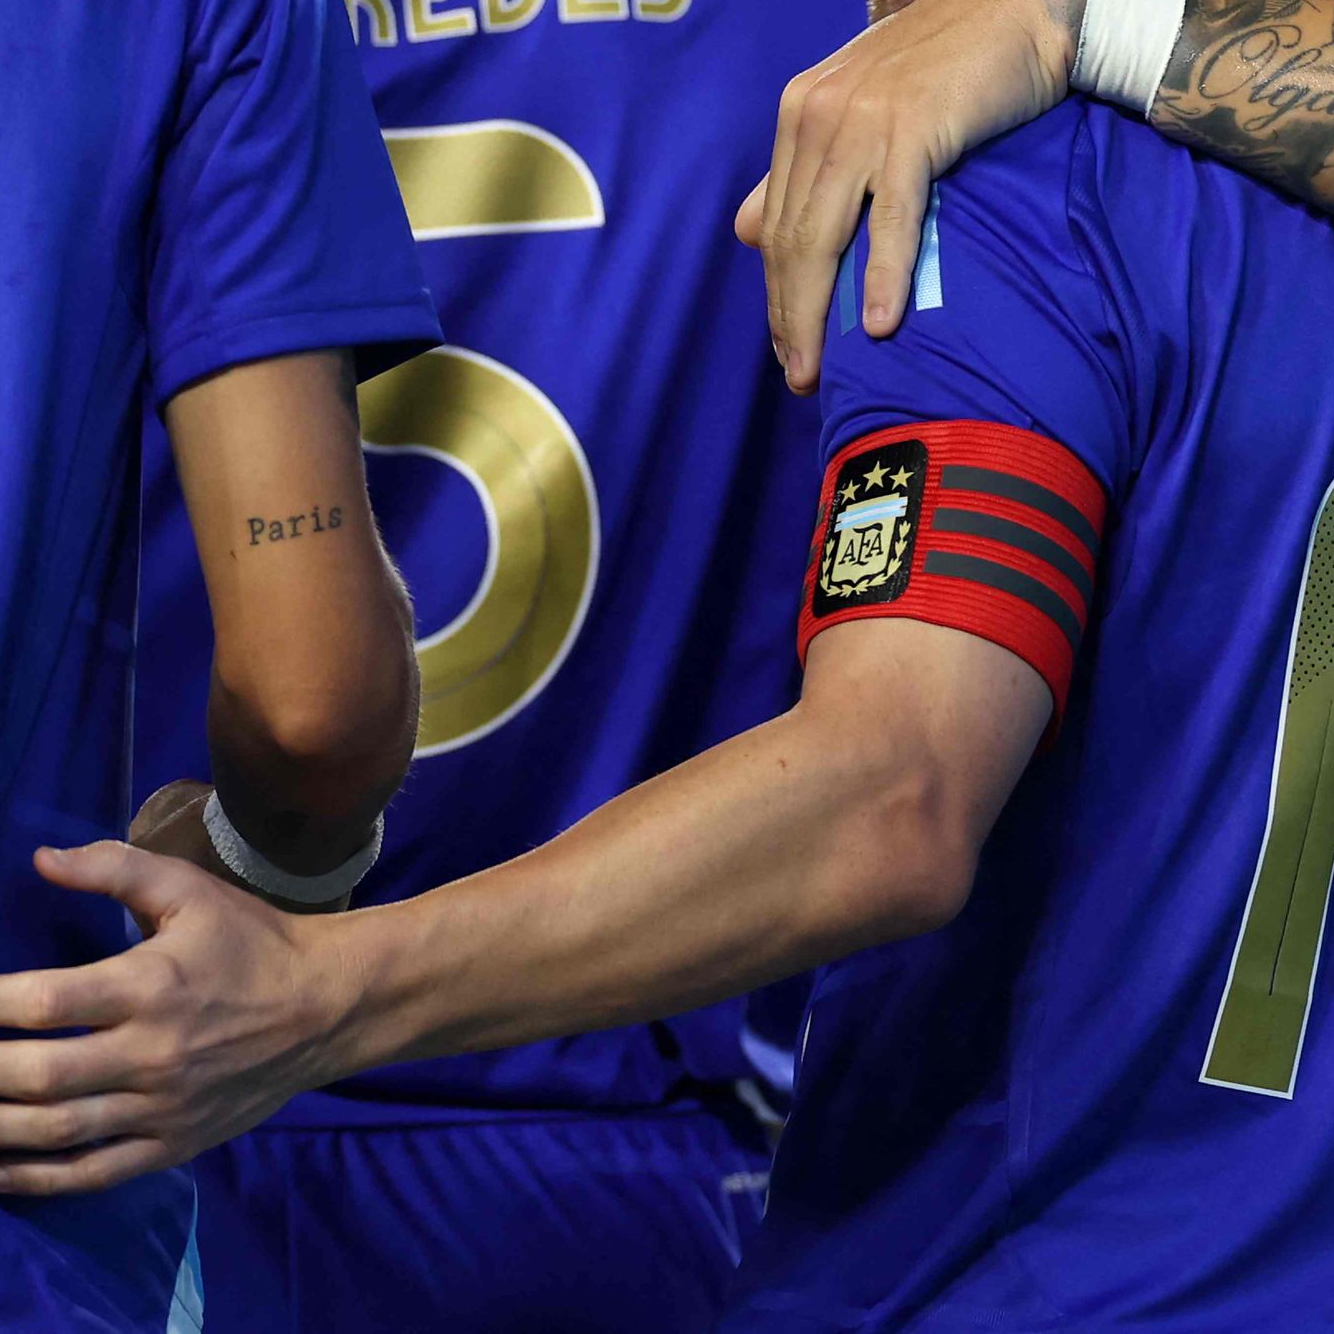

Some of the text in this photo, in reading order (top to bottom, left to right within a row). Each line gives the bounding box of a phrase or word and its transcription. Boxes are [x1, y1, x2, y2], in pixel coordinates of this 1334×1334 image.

[357, 119, 605, 758] 5
[247, 506, 343, 546] Paris
[838, 523, 884, 566] AFA
